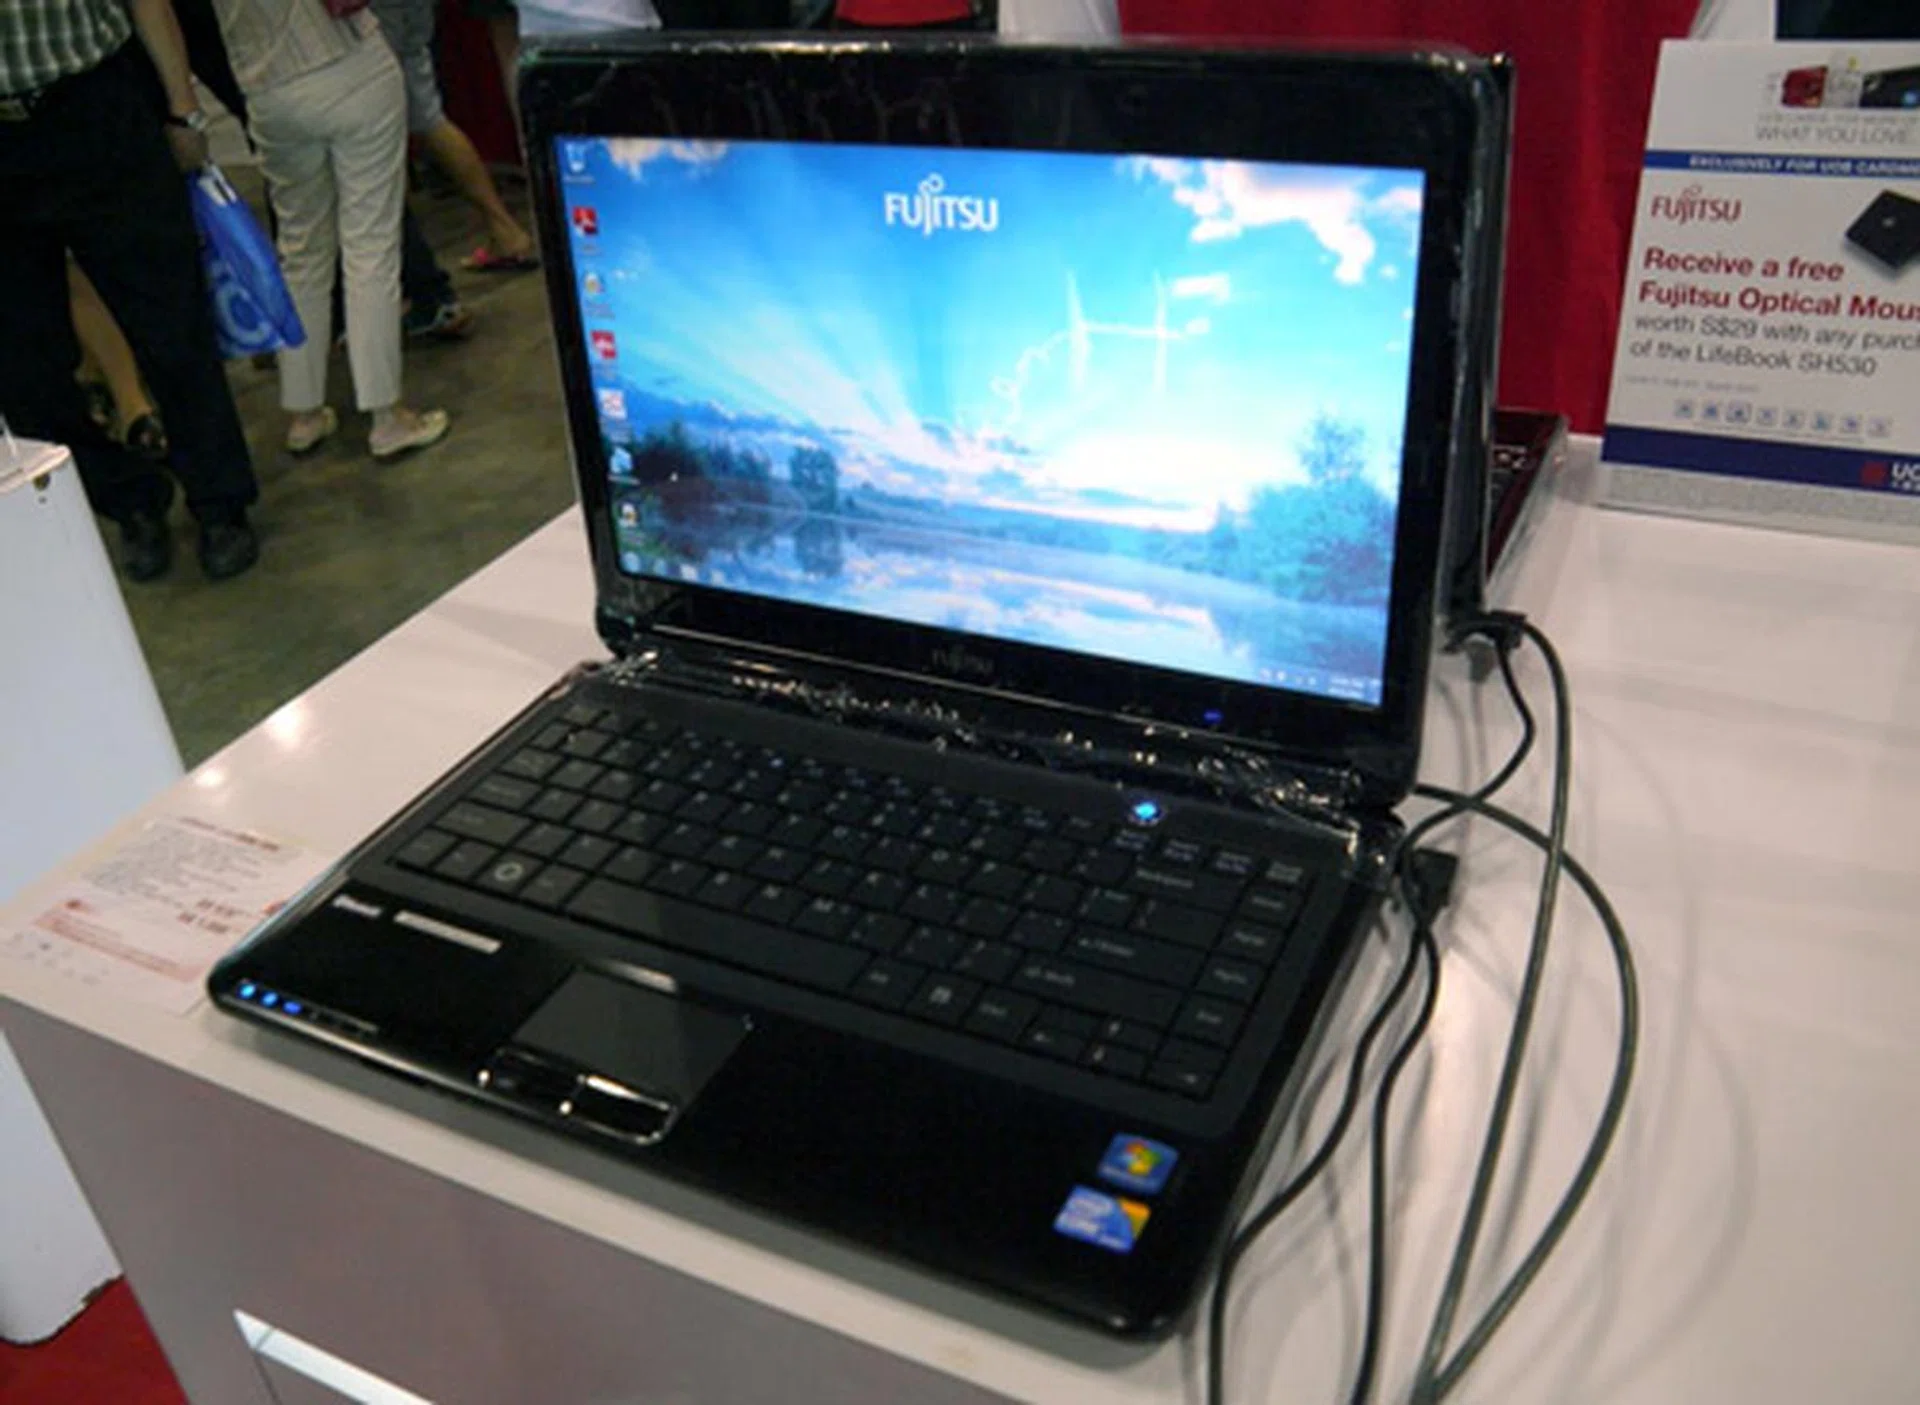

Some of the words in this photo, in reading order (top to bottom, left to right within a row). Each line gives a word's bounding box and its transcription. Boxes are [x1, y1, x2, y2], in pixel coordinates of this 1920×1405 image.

[884, 172, 999, 237] FUJITSU
[1650, 185, 1742, 225] FUJITSU
[1643, 247, 1753, 277] Receive
[1761, 260, 1779, 278] a
[1787, 256, 1844, 282] free
[1638, 280, 1730, 308] Fujitsu
[1738, 287, 1840, 316] Optical
[1635, 314, 1695, 335] worth
[1700, 316, 1758, 338] S$29
[1763, 322, 1809, 343] with
[1815, 328, 1856, 351] any
[1629, 339, 1653, 357] of
[1657, 341, 1691, 359] the
[1696, 343, 1792, 368] LifeBook
[1798, 350, 1877, 377] SH530
